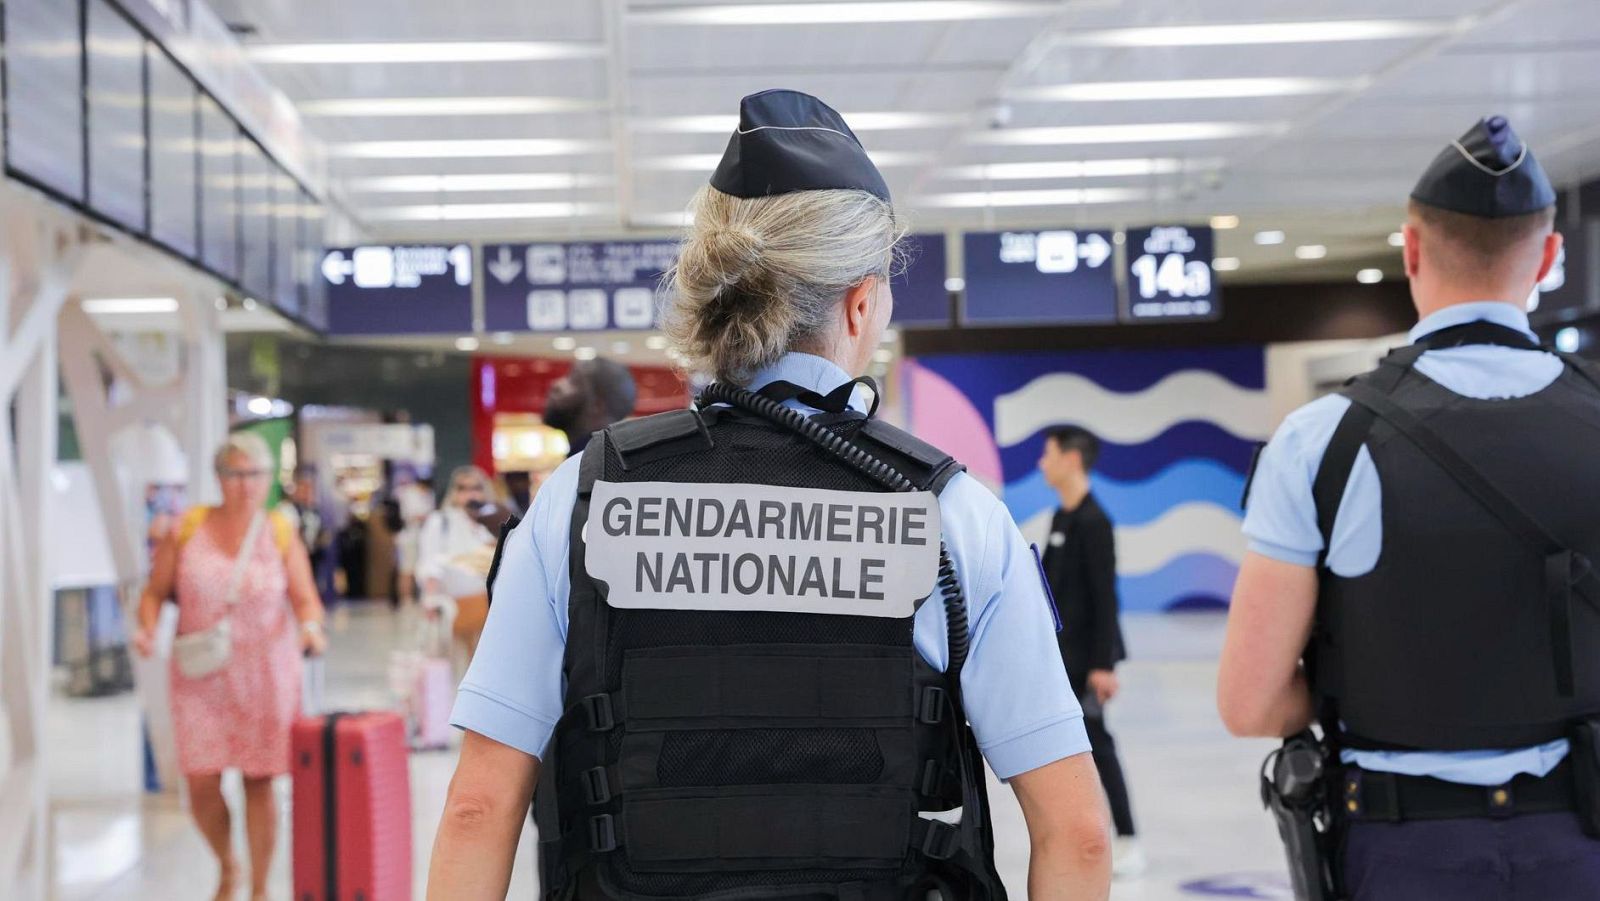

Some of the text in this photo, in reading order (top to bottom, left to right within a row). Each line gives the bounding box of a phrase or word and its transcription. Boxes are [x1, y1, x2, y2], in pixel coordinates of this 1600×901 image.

[450, 244, 471, 286] 1
[1131, 253, 1211, 298] 14a
[602, 497, 928, 546] GENDARMERIE
[635, 552, 886, 601] NATIONALE
